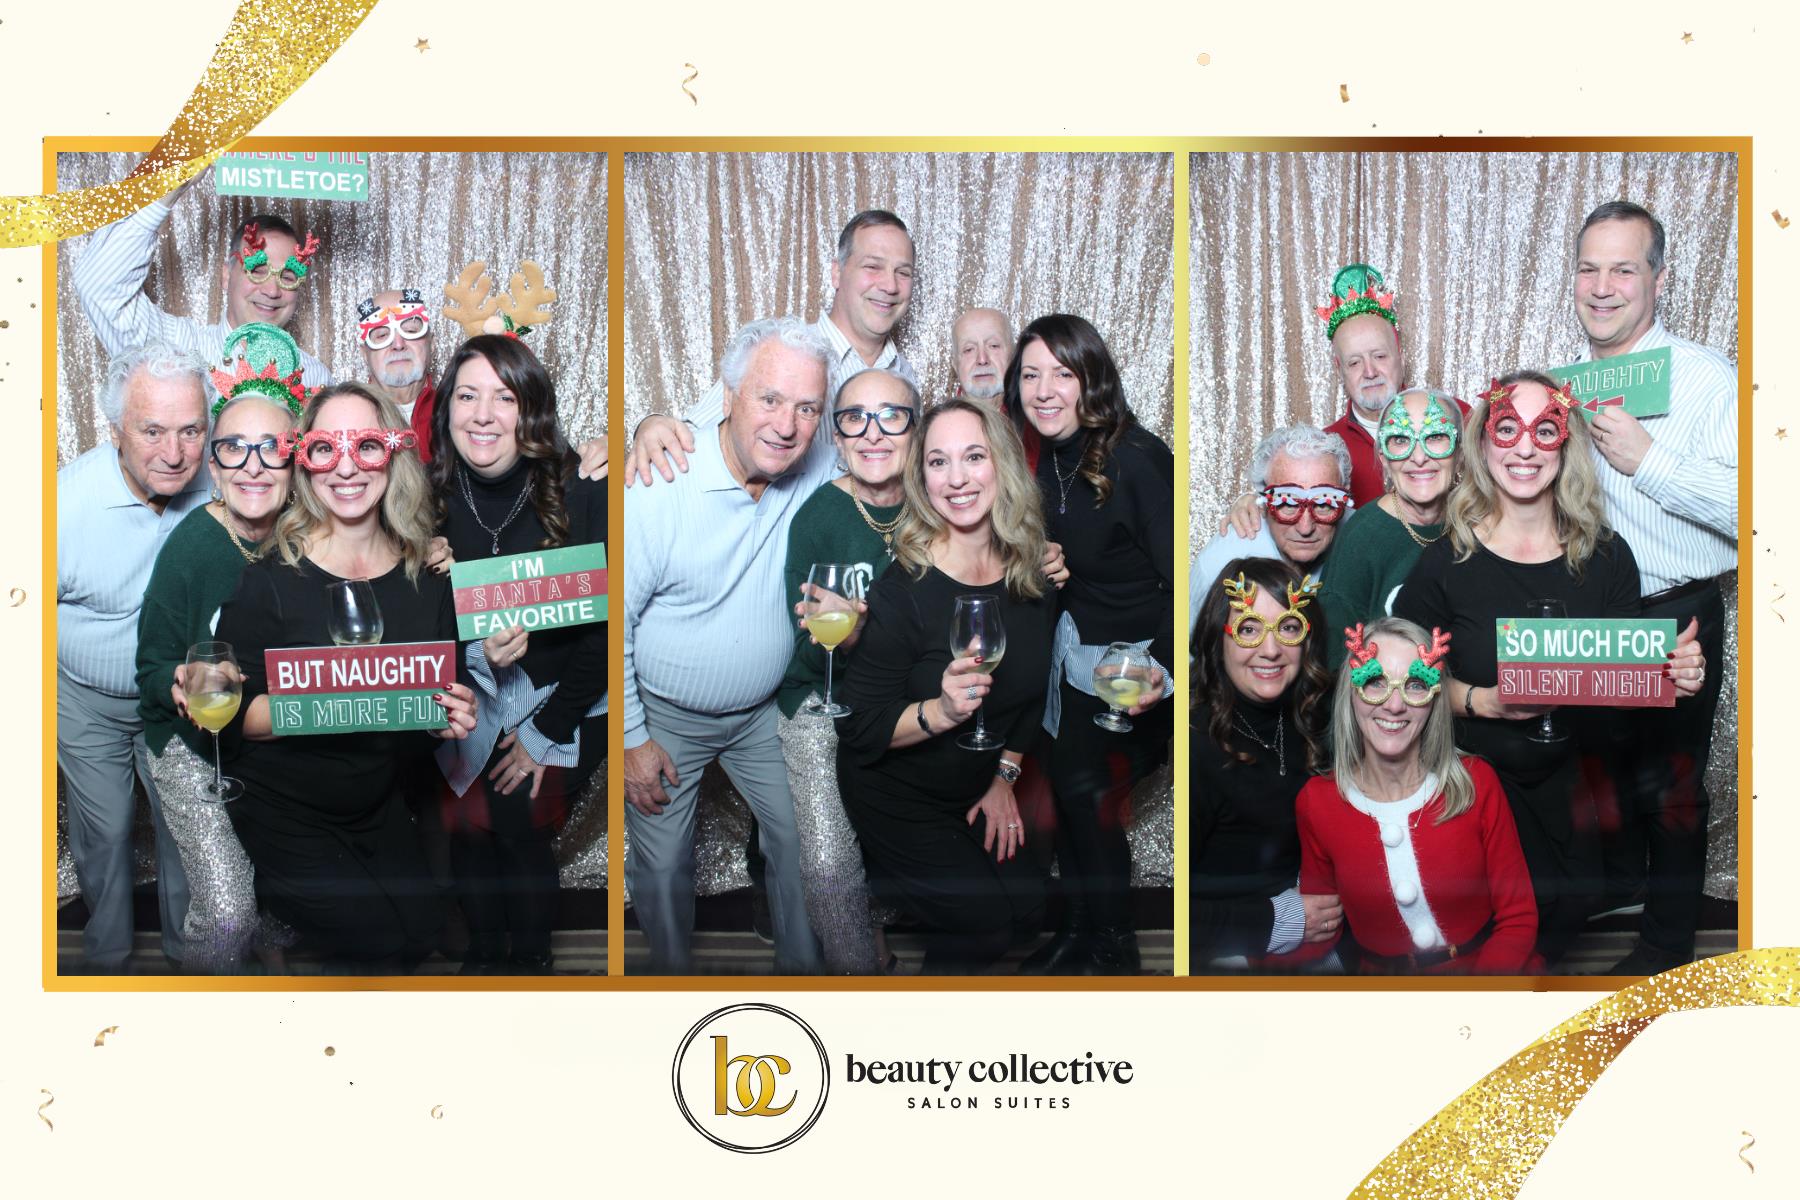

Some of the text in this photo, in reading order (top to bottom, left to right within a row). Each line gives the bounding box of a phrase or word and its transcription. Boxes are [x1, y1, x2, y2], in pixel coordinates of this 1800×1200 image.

[222, 167, 364, 192] MISTLETOE?
[1561, 359, 1665, 395] AUGHTY
[511, 557, 545, 579] I'M
[472, 573, 592, 609] SANTA'S
[473, 600, 595, 634] FAVORITE
[1505, 629, 1666, 658] SO MUCH FOR
[277, 655, 446, 689] BUT NAUGHTY
[1501, 669, 1664, 697] SILENT NIGHT
[275, 701, 302, 728] IS
[312, 698, 388, 727] MORE
